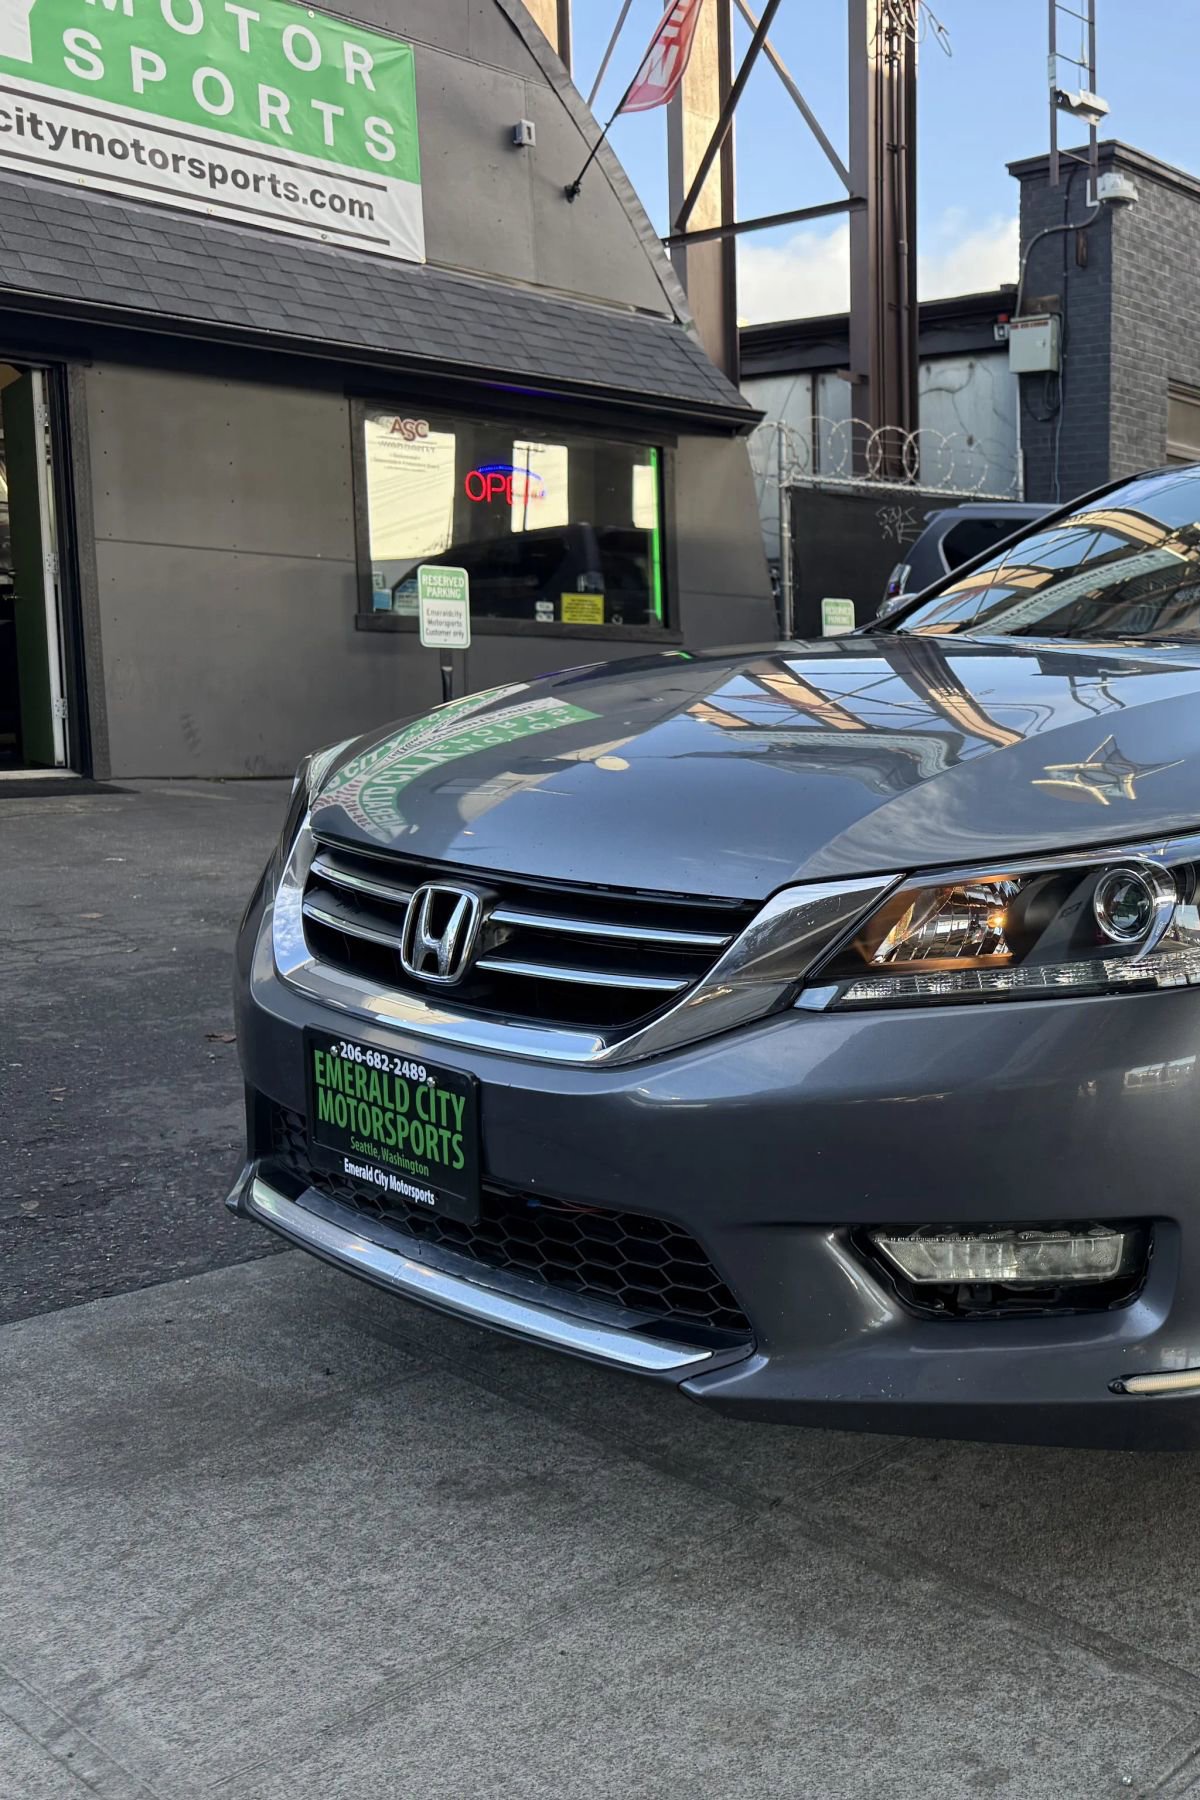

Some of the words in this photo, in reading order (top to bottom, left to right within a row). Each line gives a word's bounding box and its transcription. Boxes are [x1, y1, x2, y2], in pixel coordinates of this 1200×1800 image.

[62, 28, 397, 162] SPORTS
[0, 106, 375, 222] citymotorsports.com
[421, 574, 465, 588] RESERVED
[426, 586, 462, 599] PARKING
[339, 1041, 427, 1082] 206-682-2489
[314, 1049, 410, 1114] EMERALD
[415, 1084, 466, 1131] CITY
[318, 1087, 465, 1170] MOTORSPORTS
[350, 1135, 381, 1160] Seattle,
[381, 1147, 430, 1177] Washington
[344, 1157, 373, 1182] Emerald
[374, 1168, 389, 1191] City
[389, 1174, 435, 1205] Motorsports
